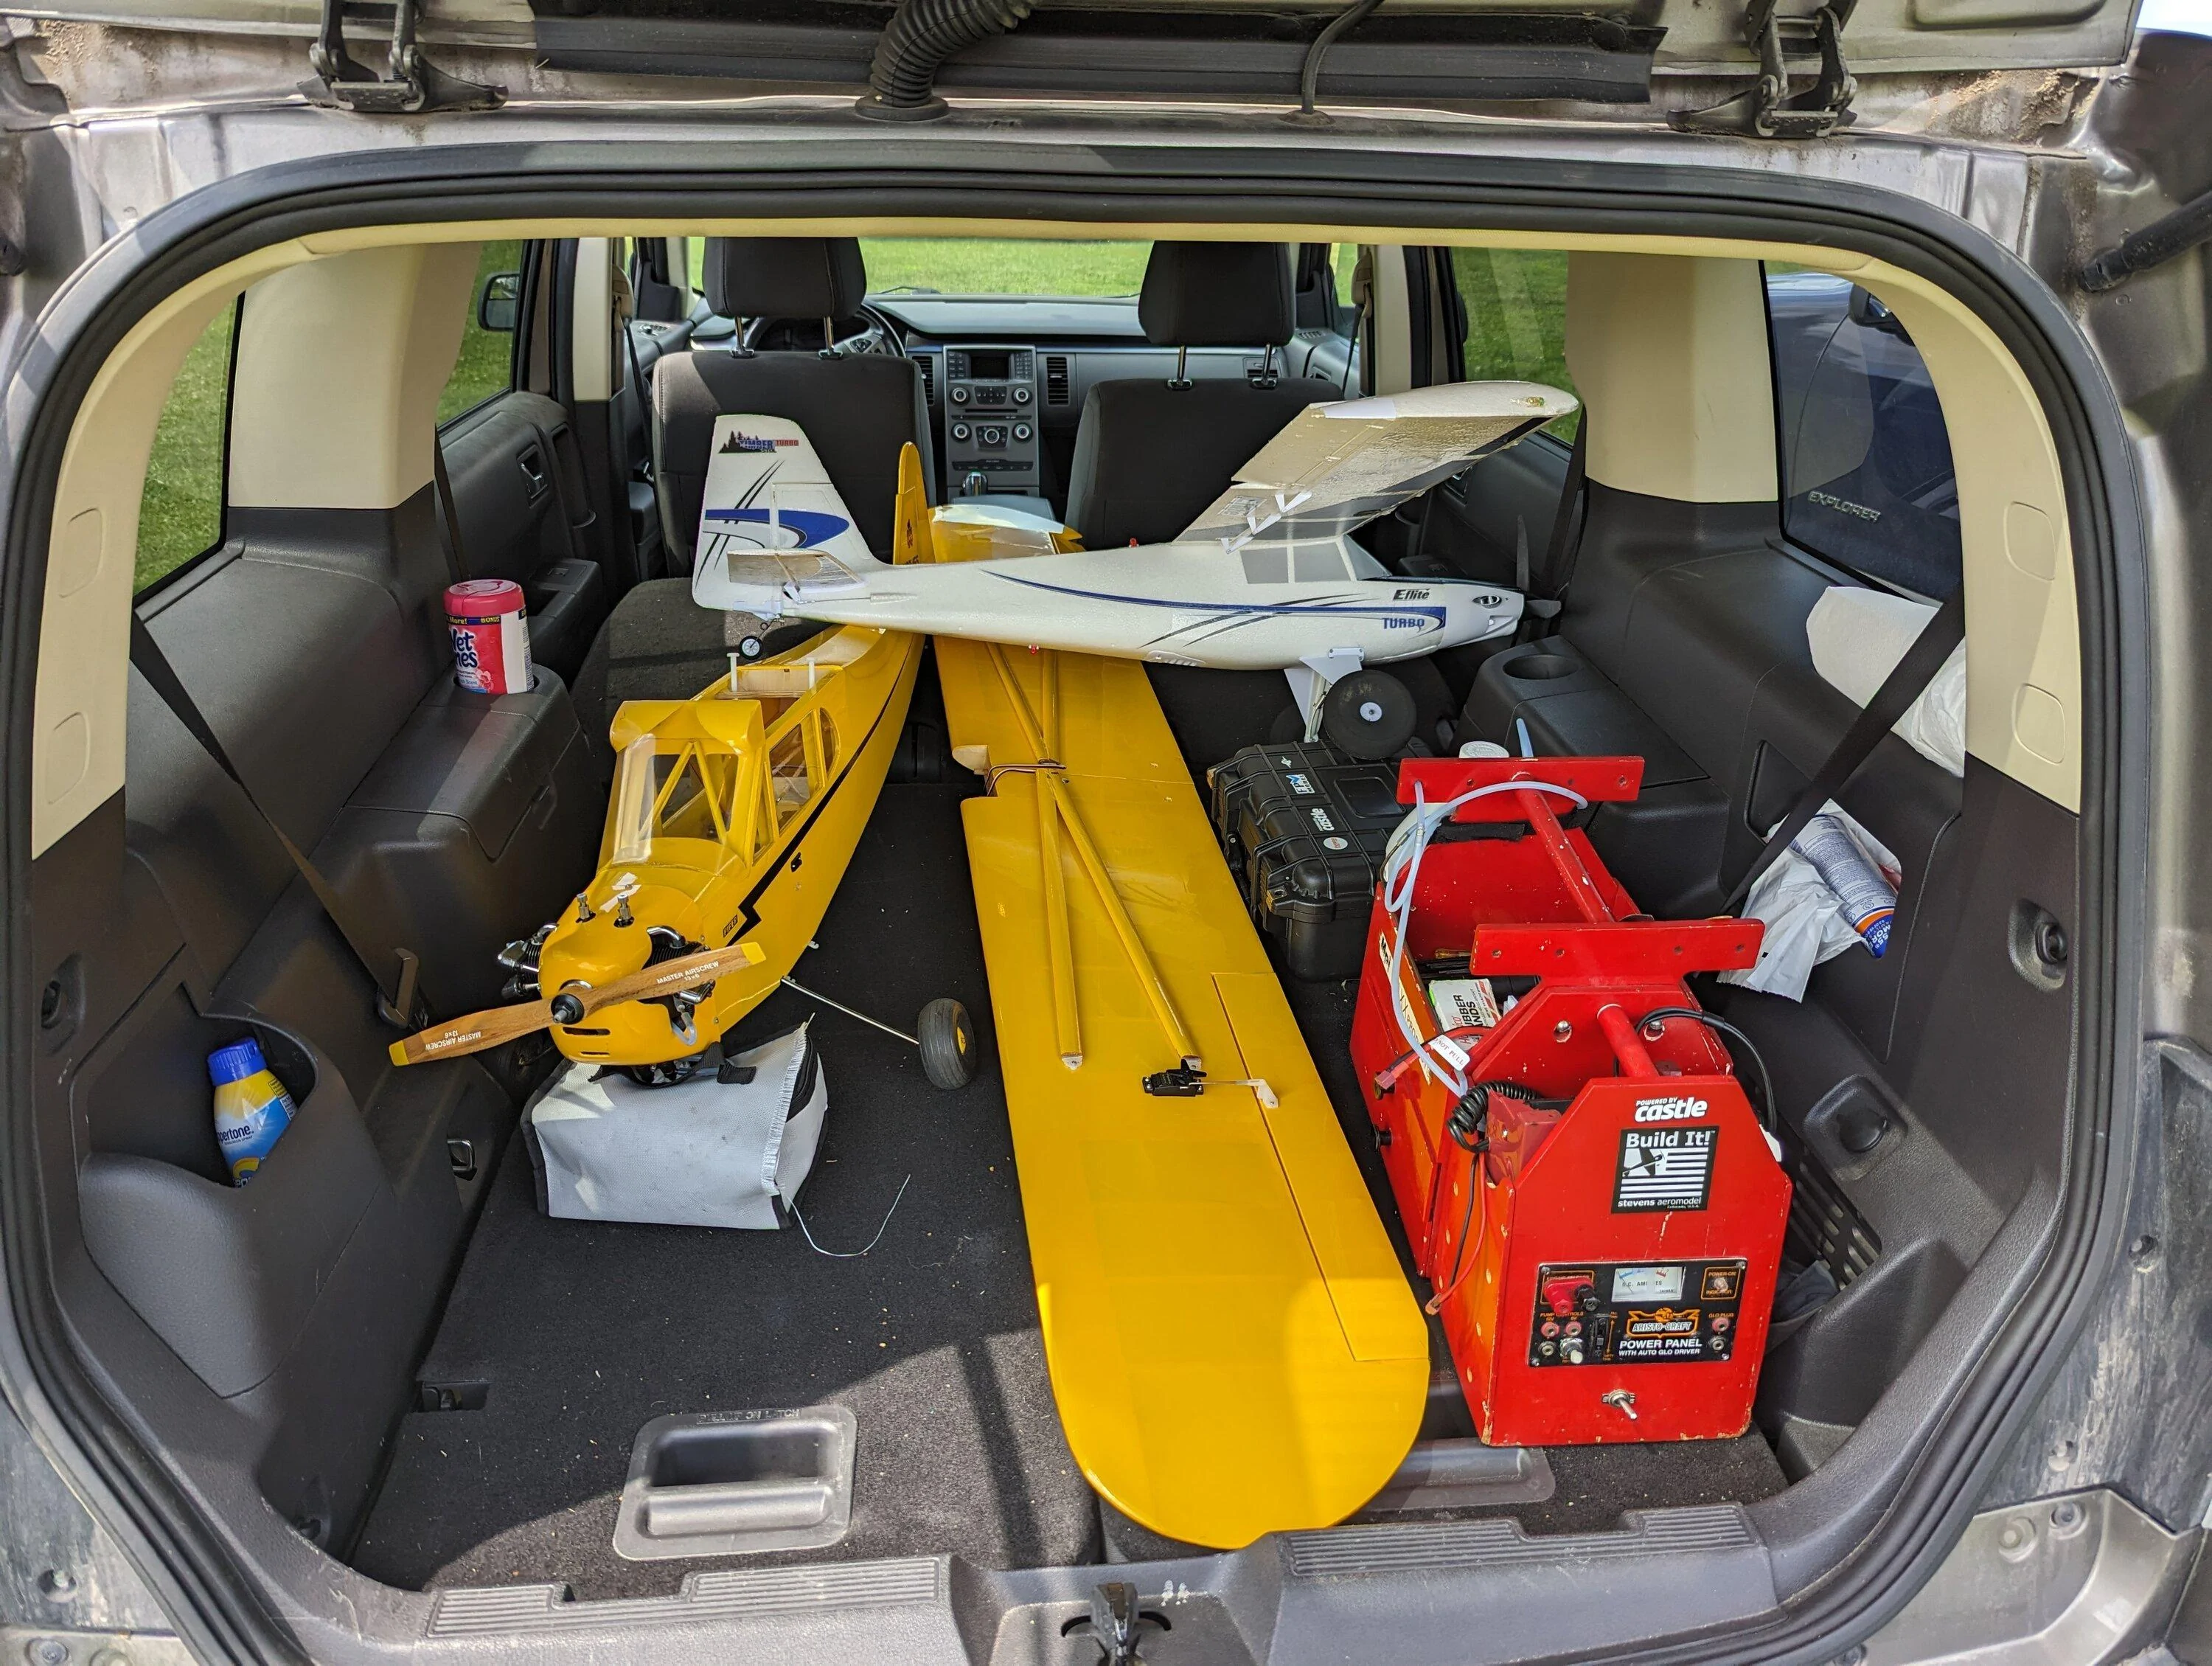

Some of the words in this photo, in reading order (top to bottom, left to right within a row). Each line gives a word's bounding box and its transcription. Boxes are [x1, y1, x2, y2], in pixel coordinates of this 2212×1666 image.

[776, 439, 799, 447] TURBO
[1808, 490, 1881, 522] EXPLORER
[481, 616, 500, 624] BONUS
[1382, 617, 1425, 630] TURBO
[1310, 808, 1335, 831] castle
[656, 972, 684, 984] MASTER
[684, 960, 719, 976] AIRSCREW
[1453, 994, 1474, 1027] UBBER
[1466, 1001, 1484, 1027] ANDS
[425, 1037, 456, 1050] AIRSCREW
[457, 1031, 481, 1043] MASTER
[1449, 1049, 1464, 1066] PULL
[1635, 1097, 1708, 1122] castle
[1636, 1098, 1667, 1106] POWERED
[1626, 1131, 1679, 1148] Build
[1618, 1198, 1655, 1207] stevens
[1657, 1197, 1702, 1206] aeromodel
[1619, 1339, 1662, 1350] POWER
[1665, 1338, 1703, 1348] PANEL
